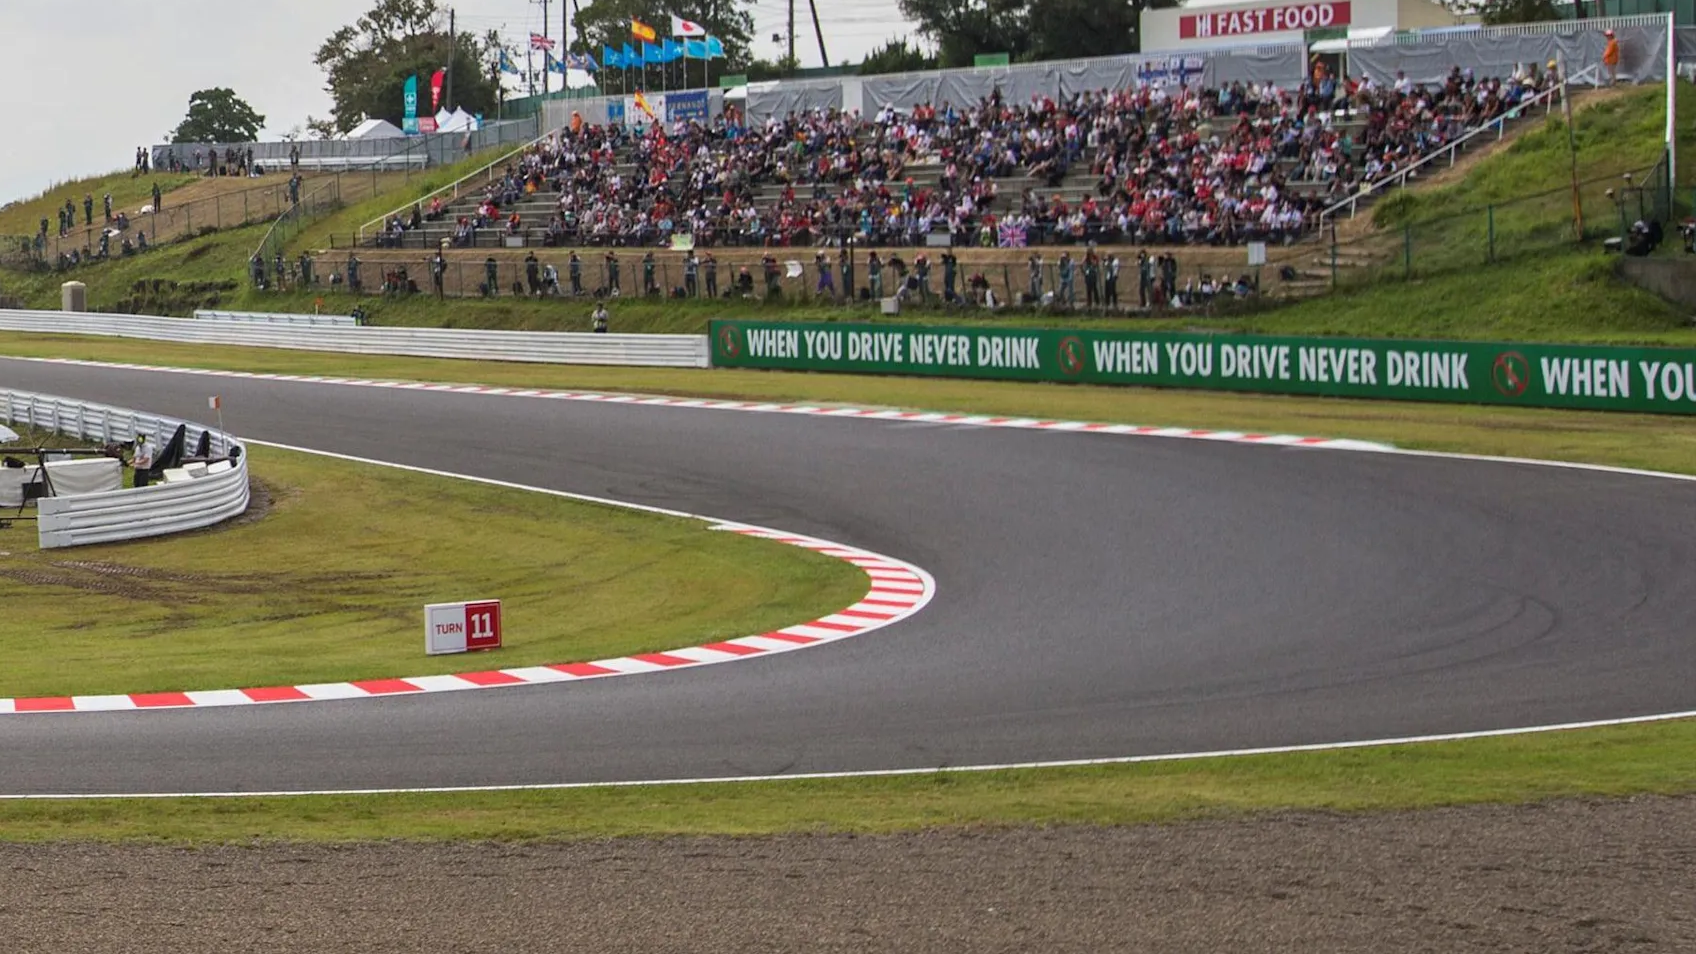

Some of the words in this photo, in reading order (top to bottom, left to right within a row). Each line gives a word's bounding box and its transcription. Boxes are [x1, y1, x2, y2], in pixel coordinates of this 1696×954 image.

[1217, 10, 1266, 35] FAST
[1273, 4, 1334, 30] FOOD
[747, 329, 798, 358] WHEN
[804, 330, 841, 360] YOU
[848, 332, 903, 362] DRIVE
[909, 334, 970, 365] NEVER
[977, 336, 1040, 369] DRINK
[1093, 341, 1158, 374] WHEN
[1165, 342, 1212, 377] YOU
[1221, 344, 1290, 380] DRIVE
[1299, 347, 1377, 385] NEVER
[1387, 351, 1469, 390] DRINK
[1540, 356, 1630, 398] WHEN
[436, 623, 464, 635] TURN
[471, 613, 494, 639] 11
